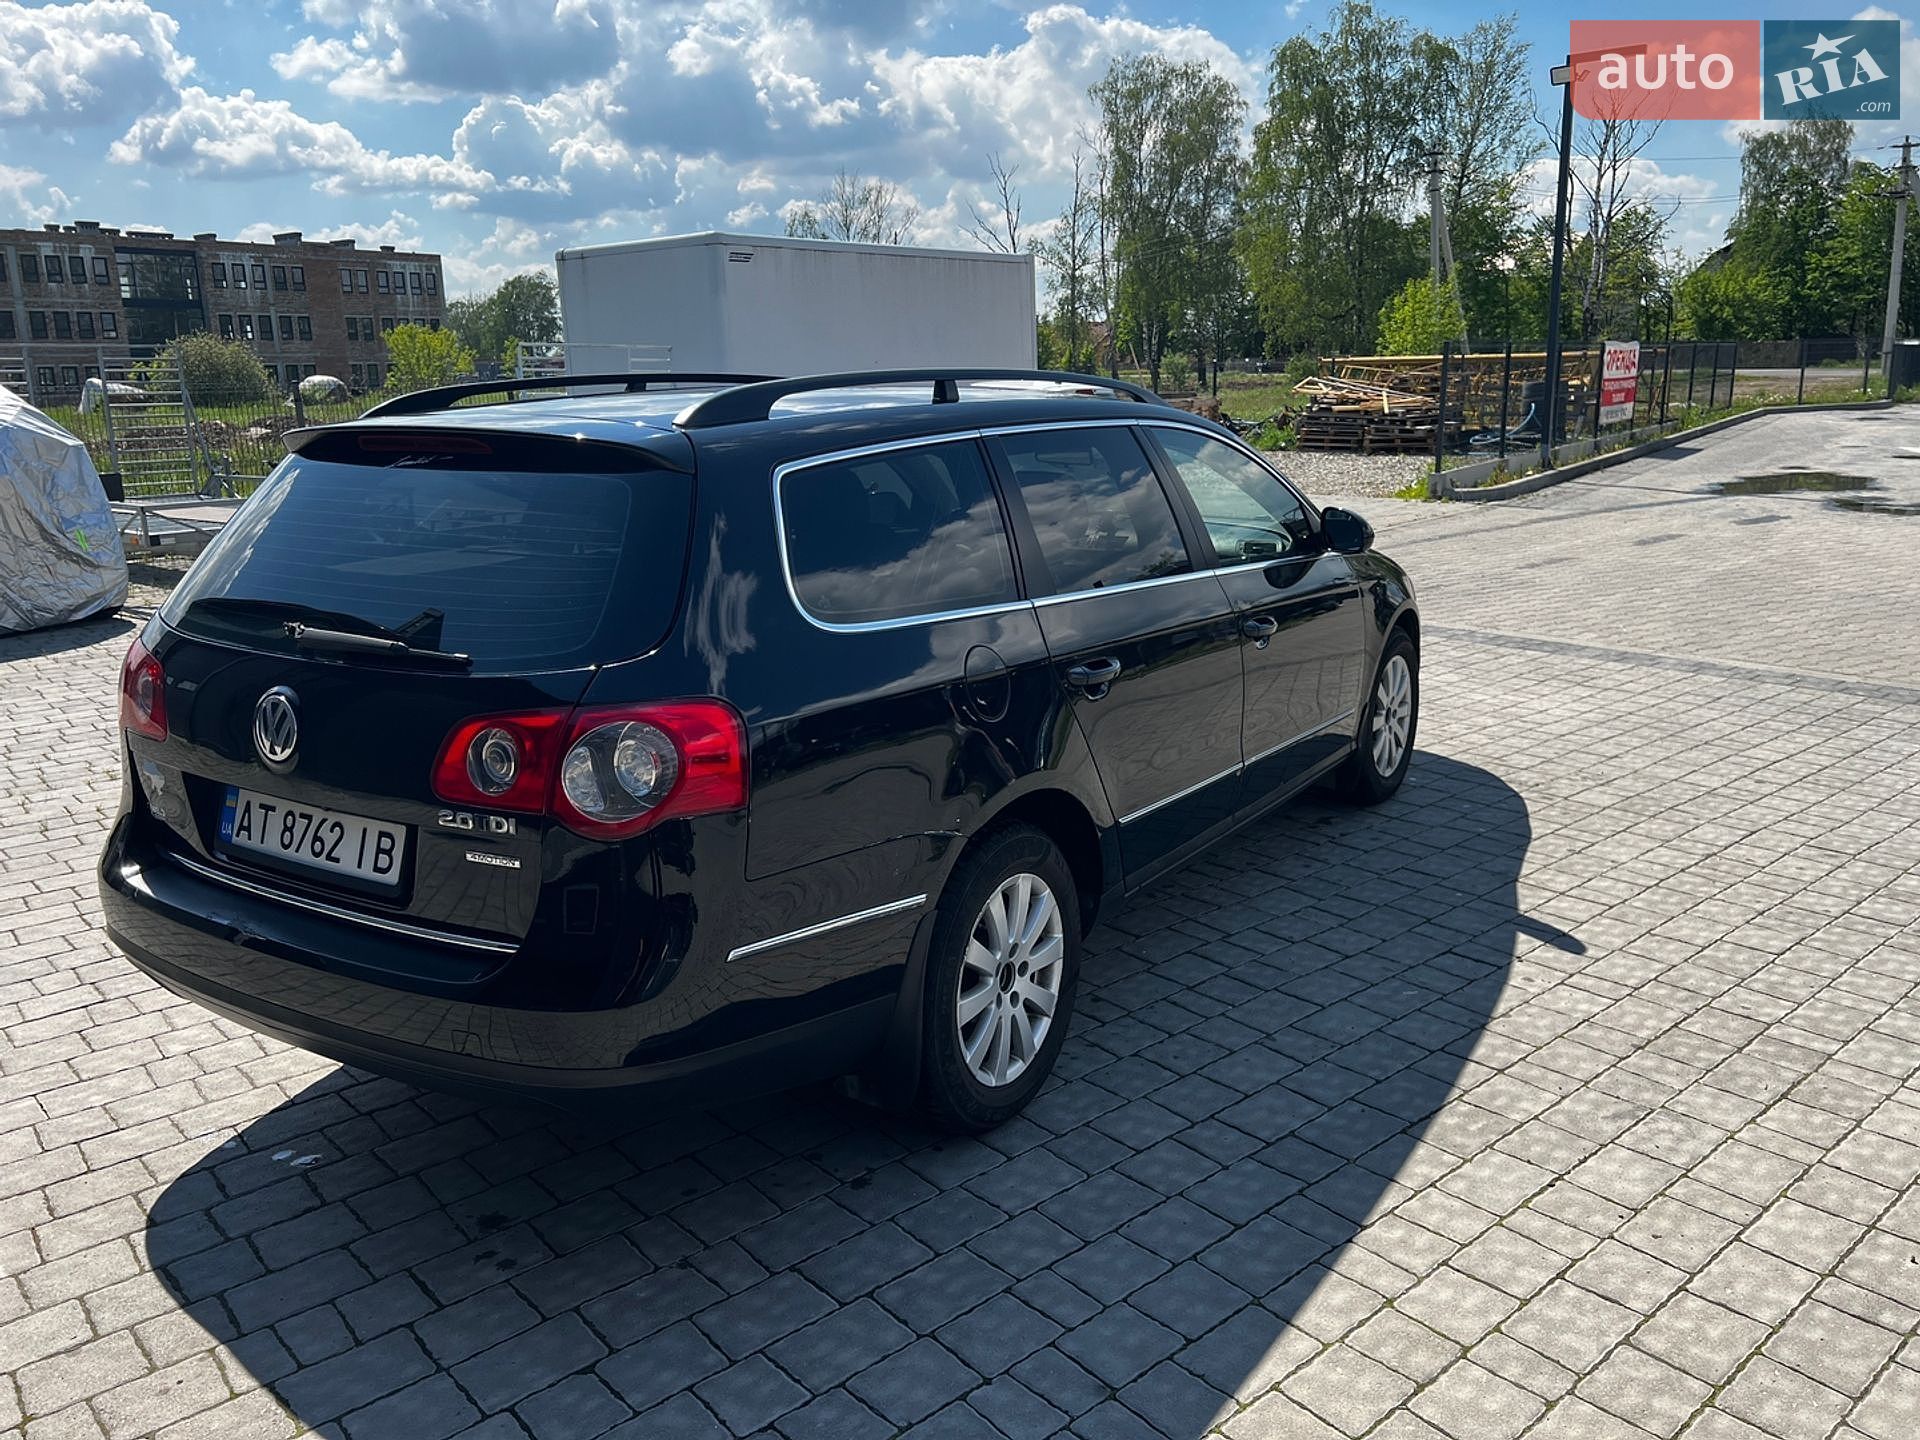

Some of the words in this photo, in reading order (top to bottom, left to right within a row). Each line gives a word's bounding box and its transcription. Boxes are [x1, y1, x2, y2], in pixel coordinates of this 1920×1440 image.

[221, 821, 232, 837] UA
[475, 813, 517, 835] TDI
[234, 799, 276, 845] AT
[279, 809, 345, 865] 8762
[356, 826, 397, 875] IB
[468, 852, 520, 868] 4MOTION
